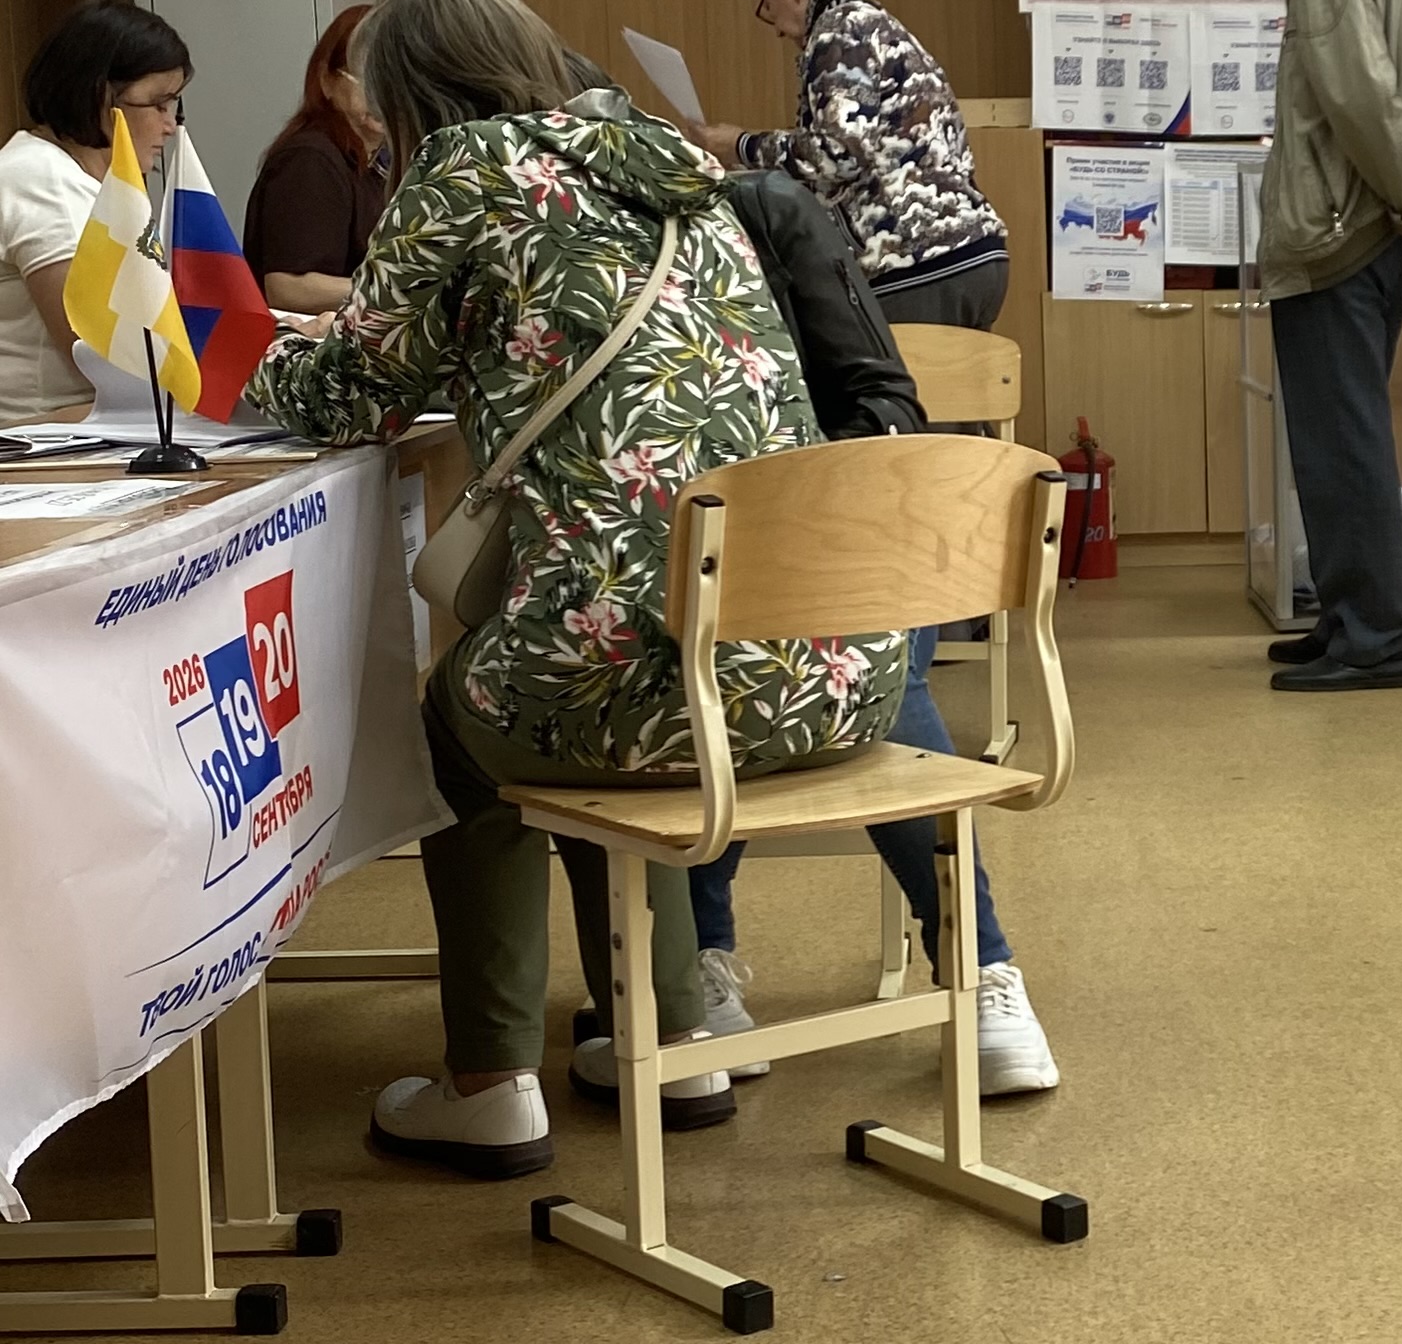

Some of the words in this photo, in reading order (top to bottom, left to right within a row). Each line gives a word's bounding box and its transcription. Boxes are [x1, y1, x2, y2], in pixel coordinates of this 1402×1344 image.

[95, 555, 185, 629] ЕДИНЫЙ
[175, 546, 221, 602] ДЕНЬ
[216, 490, 327, 573] ГОЛОСОВАНИЯ
[162, 653, 205, 706] 2026
[252, 611, 295, 703] 20
[220, 678, 266, 766] 19
[201, 749, 242, 840] 18
[139, 964, 204, 1037] ТВОЙ
[199, 931, 262, 1002] ГОЛОС
